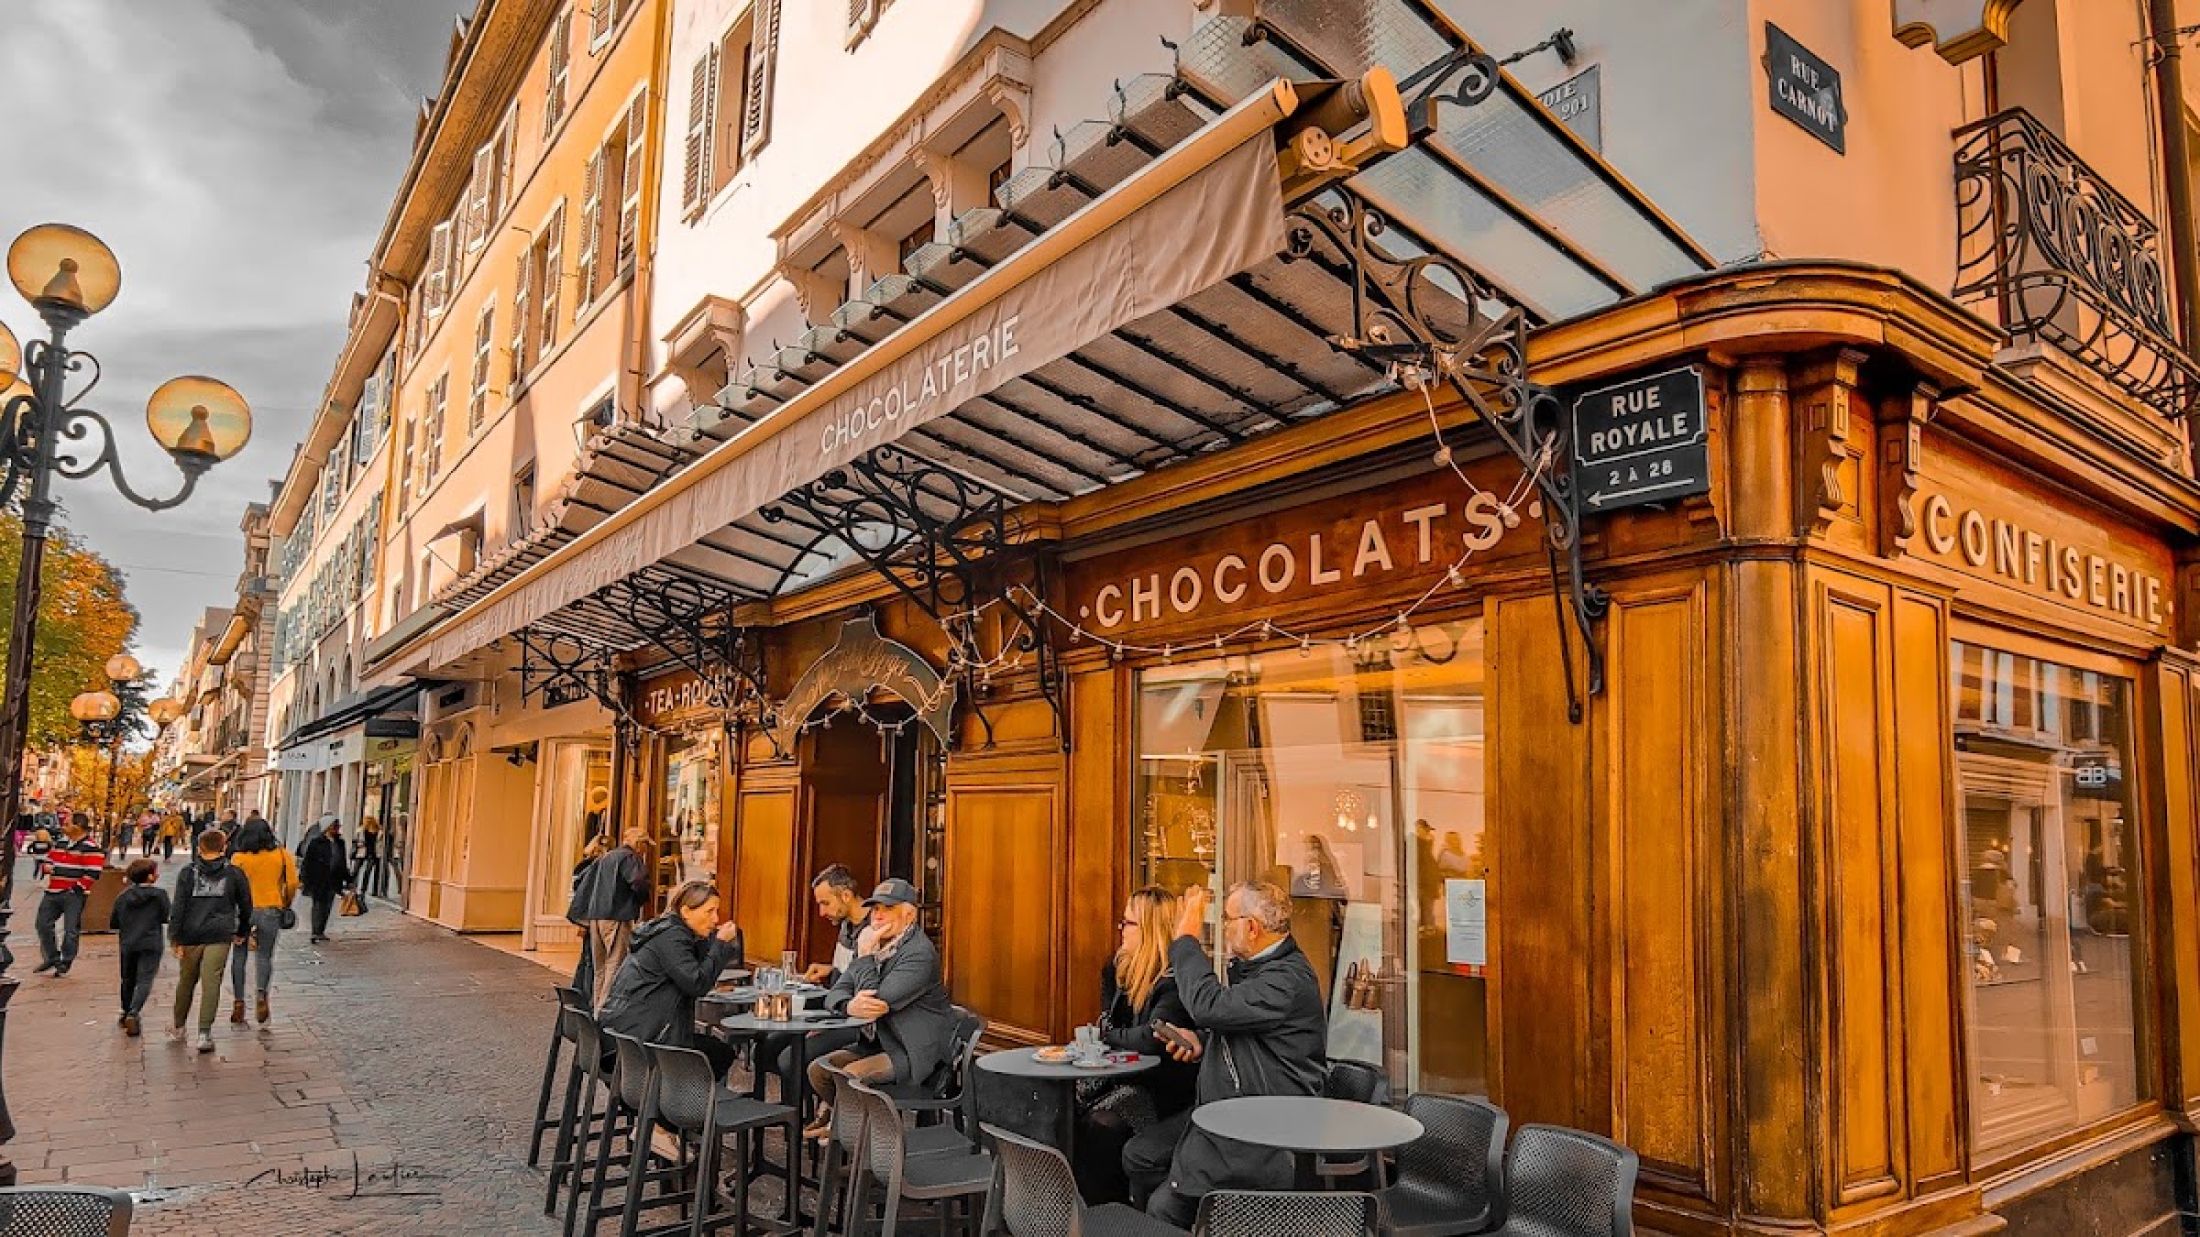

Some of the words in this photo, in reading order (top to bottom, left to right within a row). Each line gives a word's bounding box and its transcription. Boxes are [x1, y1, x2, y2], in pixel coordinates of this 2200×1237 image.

[1790, 54, 1819, 91] RUE
[1777, 78, 1837, 133] CARNOT
[820, 315, 1020, 454] CHOCOLATERIE
[1611, 386, 1661, 418] RUE
[1590, 412, 1688, 454] ROYALE
[1609, 470, 1620, 486] 2
[1650, 460, 1673, 478] 28
[1095, 492, 1505, 628] CHOCOLATS
[1924, 494, 2163, 625] CONFISERIE
